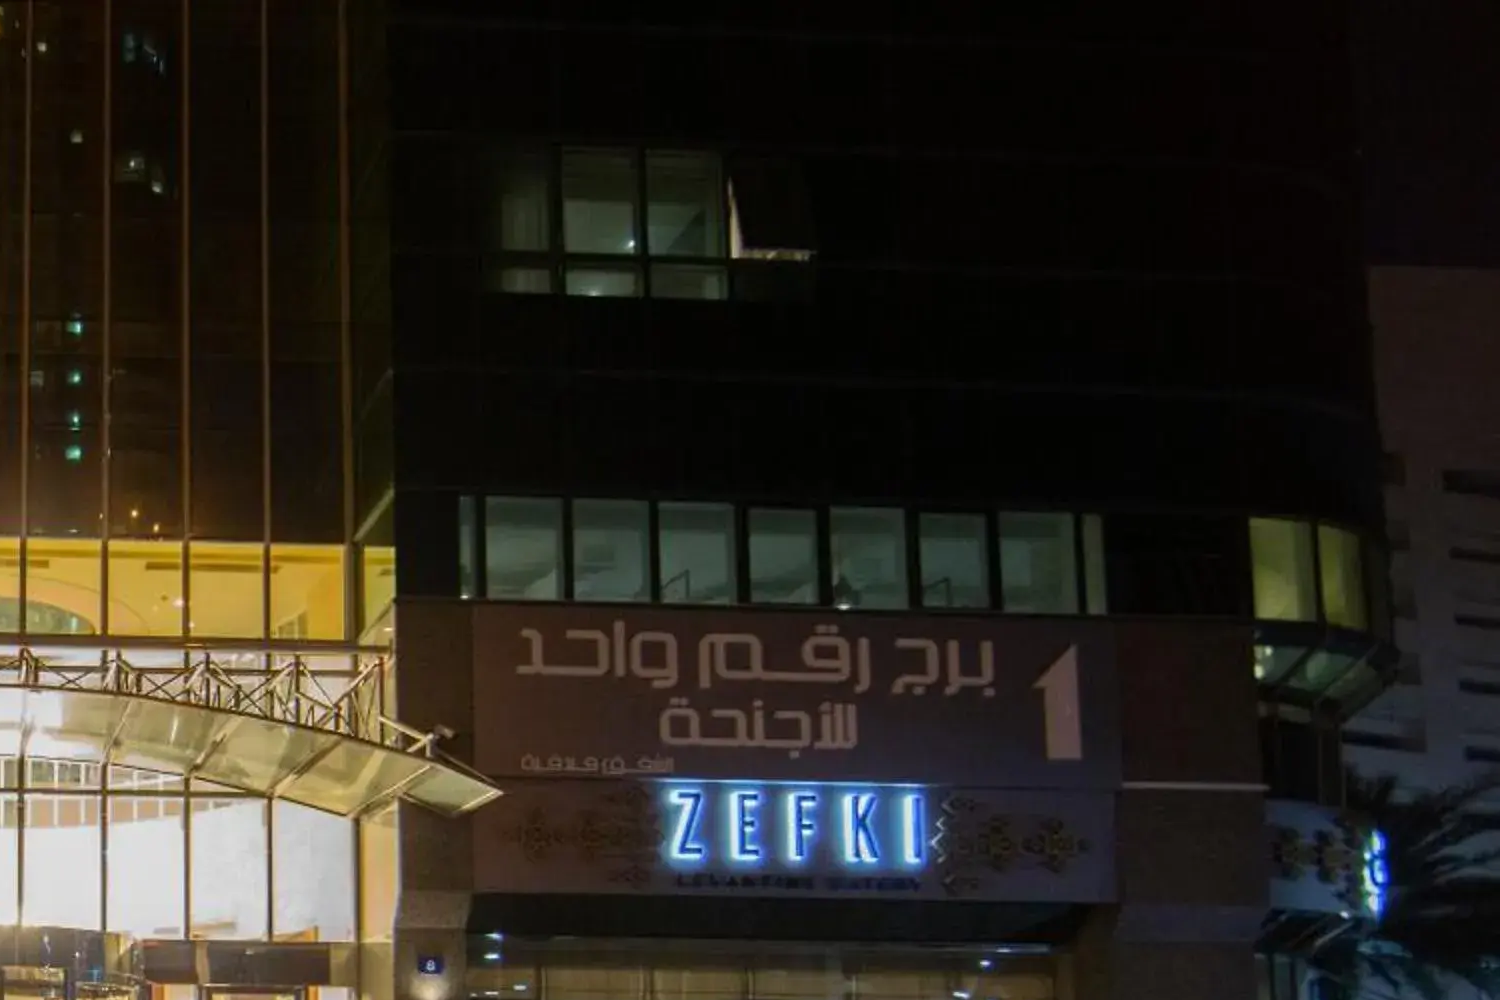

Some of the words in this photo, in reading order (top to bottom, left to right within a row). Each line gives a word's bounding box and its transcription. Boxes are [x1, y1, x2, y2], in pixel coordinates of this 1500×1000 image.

[516, 619, 680, 690] واحد
[697, 624, 873, 694] رقم
[889, 634, 997, 695] برج
[659, 698, 859, 760] للأجنحة
[1033, 643, 1083, 761] 1
[668, 789, 926, 863] ZEFKI
